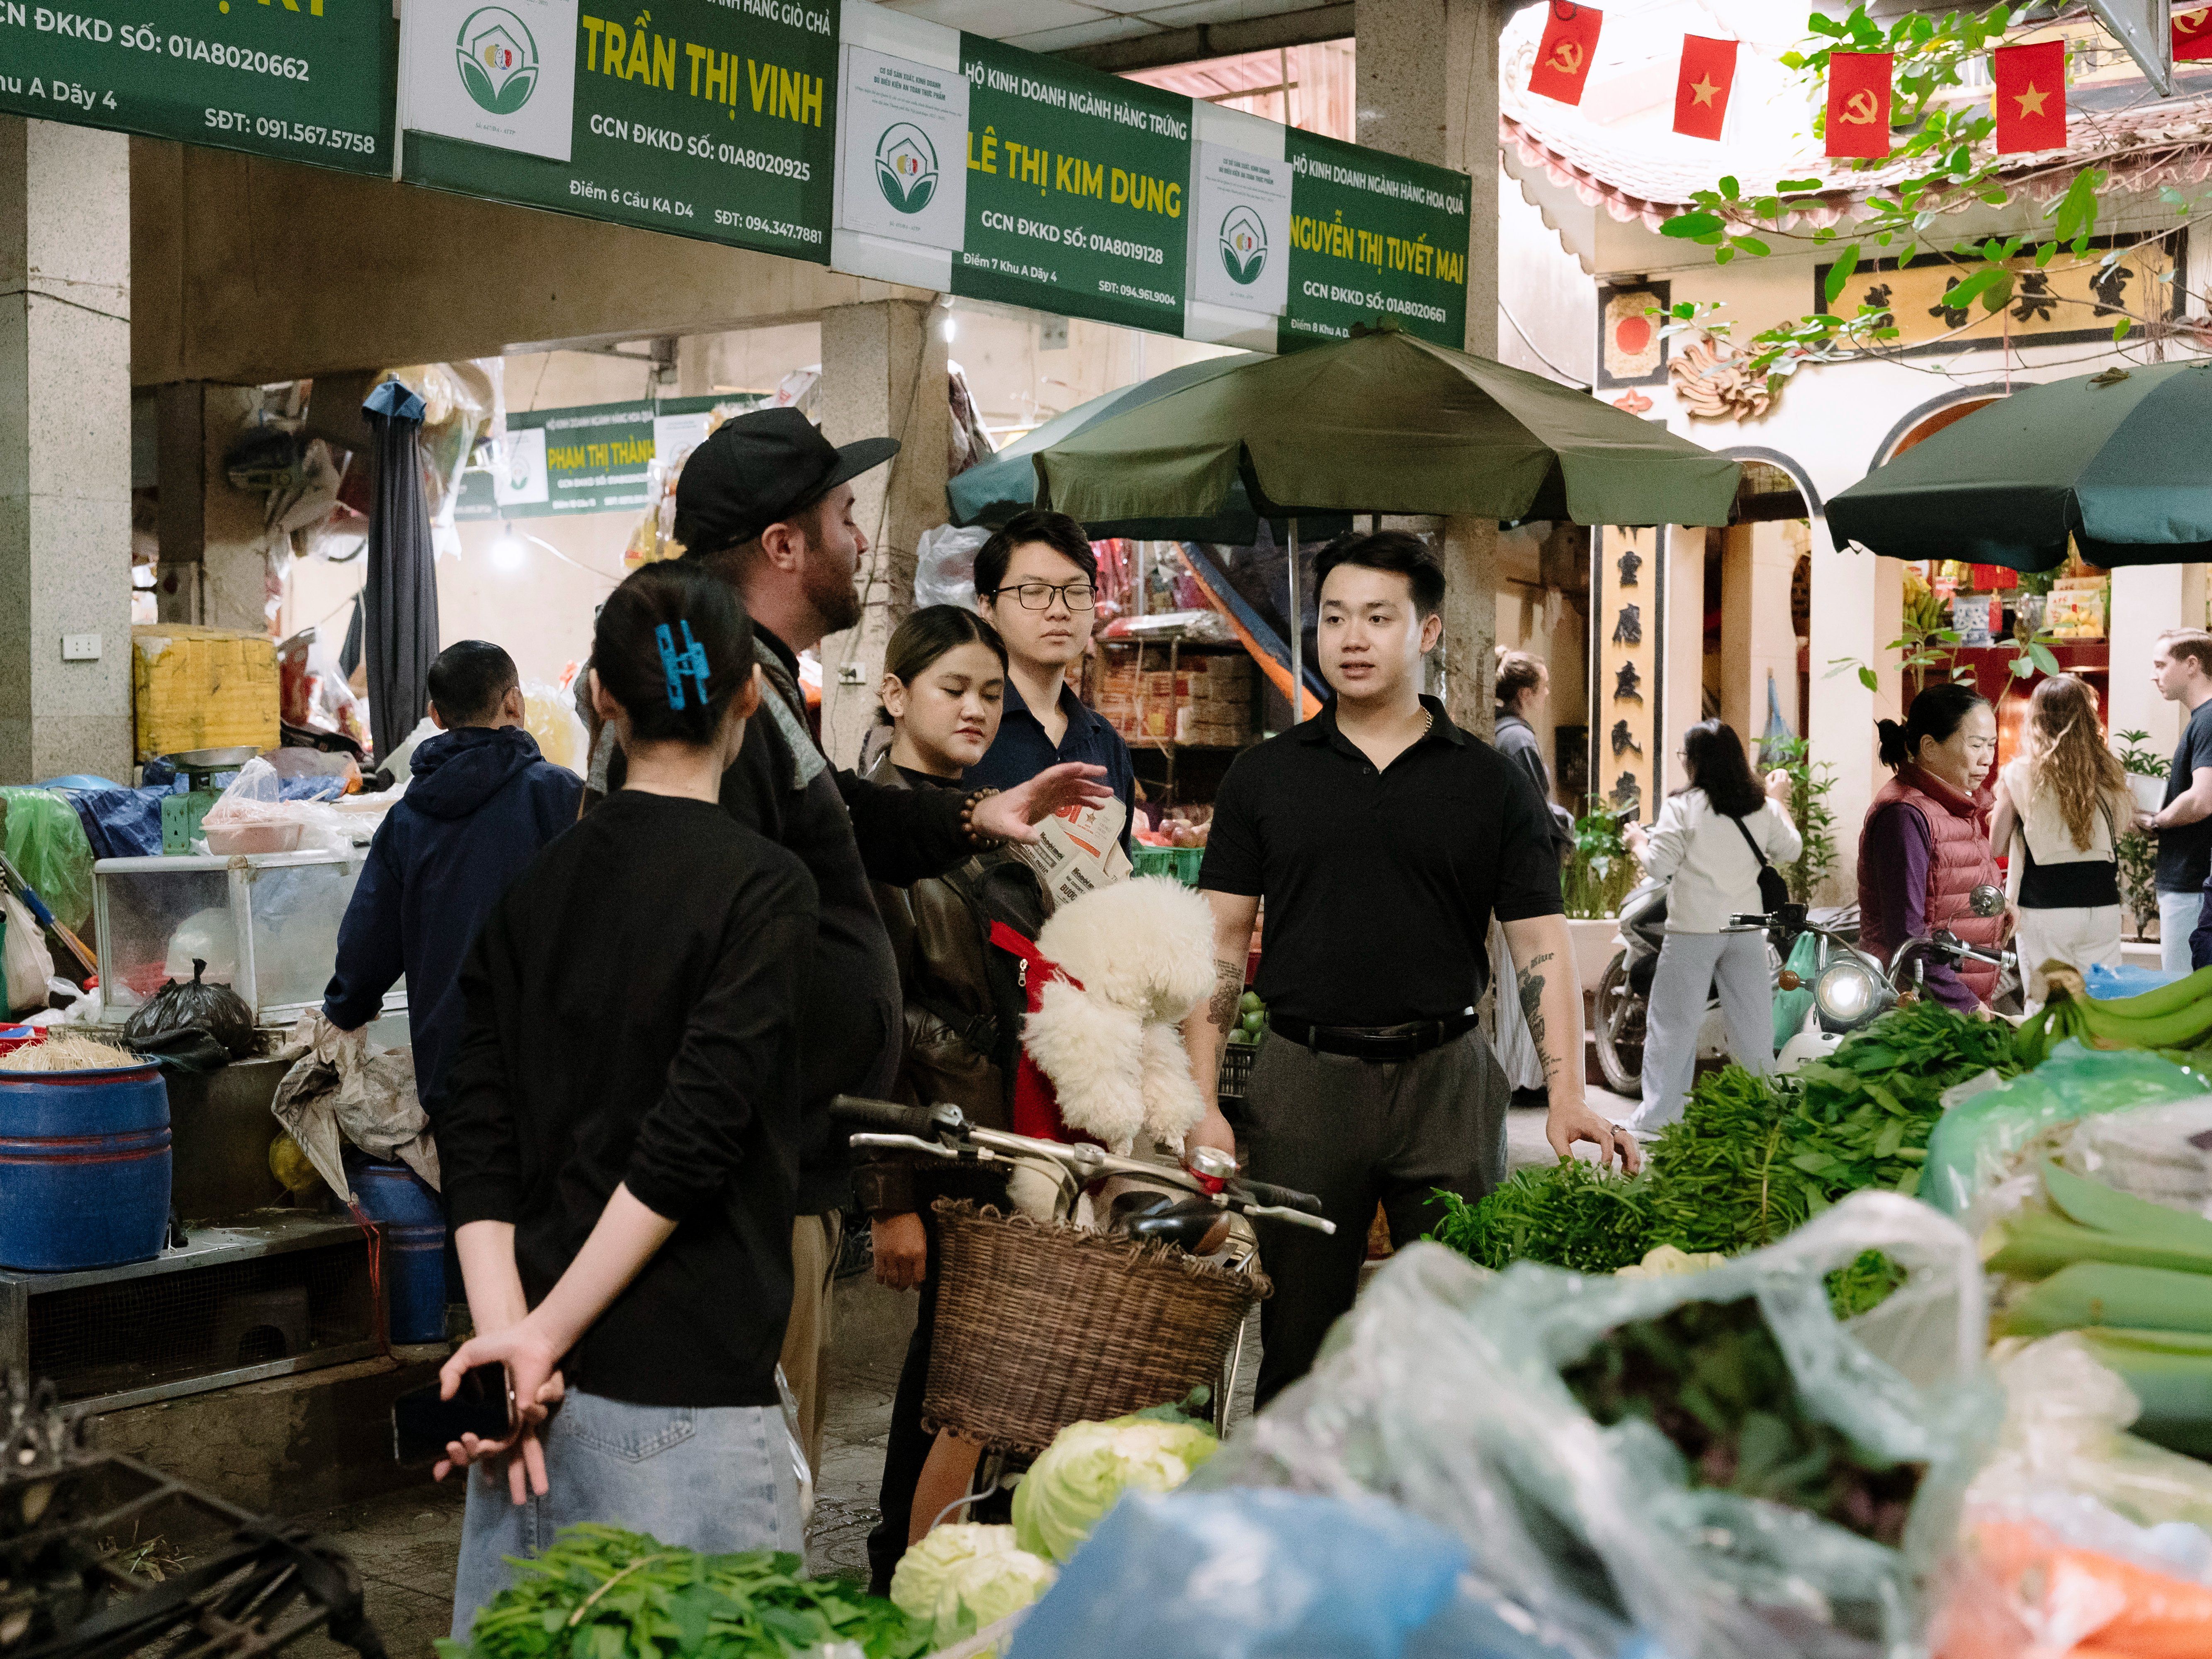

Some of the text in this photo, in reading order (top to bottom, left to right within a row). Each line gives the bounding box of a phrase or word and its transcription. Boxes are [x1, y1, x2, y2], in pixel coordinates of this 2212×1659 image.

[782, 2, 803, 27] GIÒ
[806, 9, 830, 36] CHẢ
[34, 7, 112, 42] ĐKKD
[121, 23, 161, 53] SỐ:
[169, 35, 309, 81] 01A8020662
[583, 10, 822, 127] TRẦN THỊ VINH
[29, 77, 46, 97] A
[53, 80, 96, 110] Dãy
[103, 90, 117, 109] 4
[965, 61, 1186, 140] HỘ KINH DOANH NGÀNH HÀNG TRỨNG
[205, 108, 374, 153] SĐT: 091.567.5758
[591, 114, 809, 180] GCN ĐKKD SỐ: 01A8020925
[967, 126, 997, 174] LÊ
[1005, 141, 1048, 196] THỊ
[1056, 155, 1103, 199] KIM
[1111, 168, 1181, 218] DUNG
[1292, 153, 1307, 179] HỘ
[1309, 160, 1332, 180] KINH
[1333, 166, 1366, 189] DOANH
[1368, 174, 1399, 197] NGÀNH
[1400, 181, 1424, 203] HÀNG
[1426, 190, 1444, 209] HOA
[1446, 194, 1464, 214] QUẢ
[569, 180, 693, 217] Điểm 6 Cầu KA D4
[715, 209, 822, 243] SĐT: 094.347.7881
[982, 211, 1163, 264] GCN ĐKKD SỐ: 01A8019128
[1288, 209, 1463, 284] NGUYỄN THỊ TUYẾT MAI
[963, 253, 1057, 282] Điểm 7 Khu A Dãy 4
[1099, 280, 1118, 294] SĐT:
[1303, 281, 1446, 323] GCN ĐKKD SỐ: 01A8020661
[547, 445, 586, 475] PHẠM
[586, 443, 609, 472] THỊ
